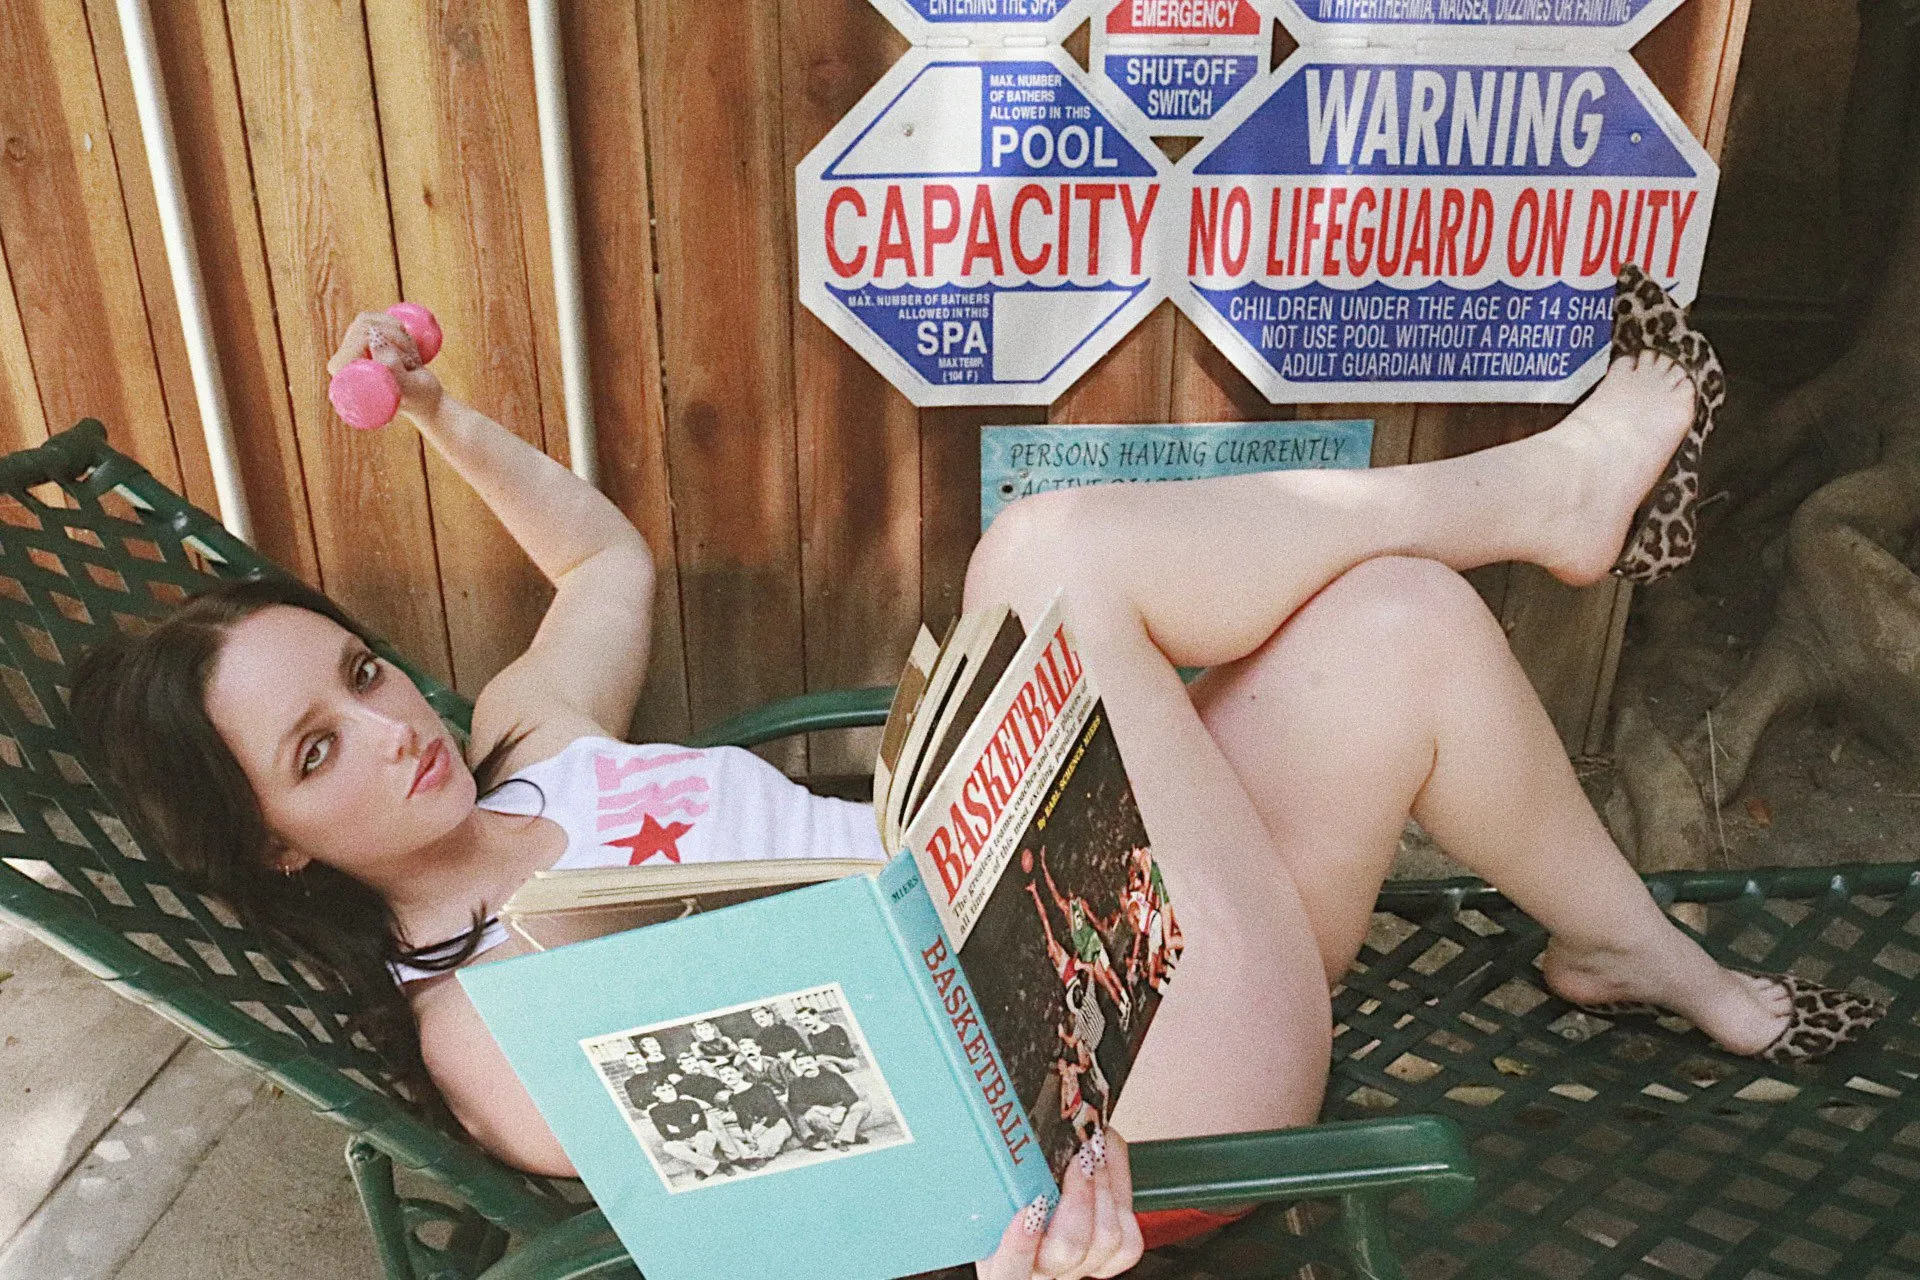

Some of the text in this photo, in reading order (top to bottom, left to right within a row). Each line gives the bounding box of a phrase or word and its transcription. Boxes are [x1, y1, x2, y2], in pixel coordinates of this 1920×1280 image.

[1131, 0, 1239, 28] EMERGENCY
[989, 74, 1062, 87] MAX. NUMBER
[1126, 58, 1238, 86] SHUT-OFF
[989, 89, 1055, 103] OF BATHERS
[1147, 88, 1213, 118] SWITCH
[989, 105, 1091, 119] ALLOWED IN THIS
[1304, 68, 1607, 169] WARNING
[991, 124, 1118, 169] POOL
[823, 183, 1161, 279] CAPACITY
[1187, 185, 1699, 278] NO LIFEGUARD ON DUTY
[848, 293, 991, 307] MAX. NUMBER OF BATHERS
[898, 307, 990, 320] ALLOWED IN THIS
[1229, 295, 1615, 321] CHILDREN UNDER THE AGE OF 14 SHAL
[916, 320, 988, 356] SPA
[1261, 324, 1595, 350] NOT USE POOL WITHOUT A PARENT OR
[1281, 352, 1571, 377] ADULT GUARDIAN IN ATTENDANCE
[1010, 438, 1346, 468] PERSONS HAVING CURRENTLY
[925, 622, 1083, 906] BASKETBALL
[952, 895, 968, 918] The
[968, 847, 994, 895] greatest
[1036, 745, 1049, 771] and
[891, 875, 919, 904] MIERS
[960, 914, 971, 935] all
[970, 886, 986, 915] time
[993, 855, 1001, 874] of
[1000, 836, 1013, 859] this
[921, 934, 1033, 1166] BASKETBALL
